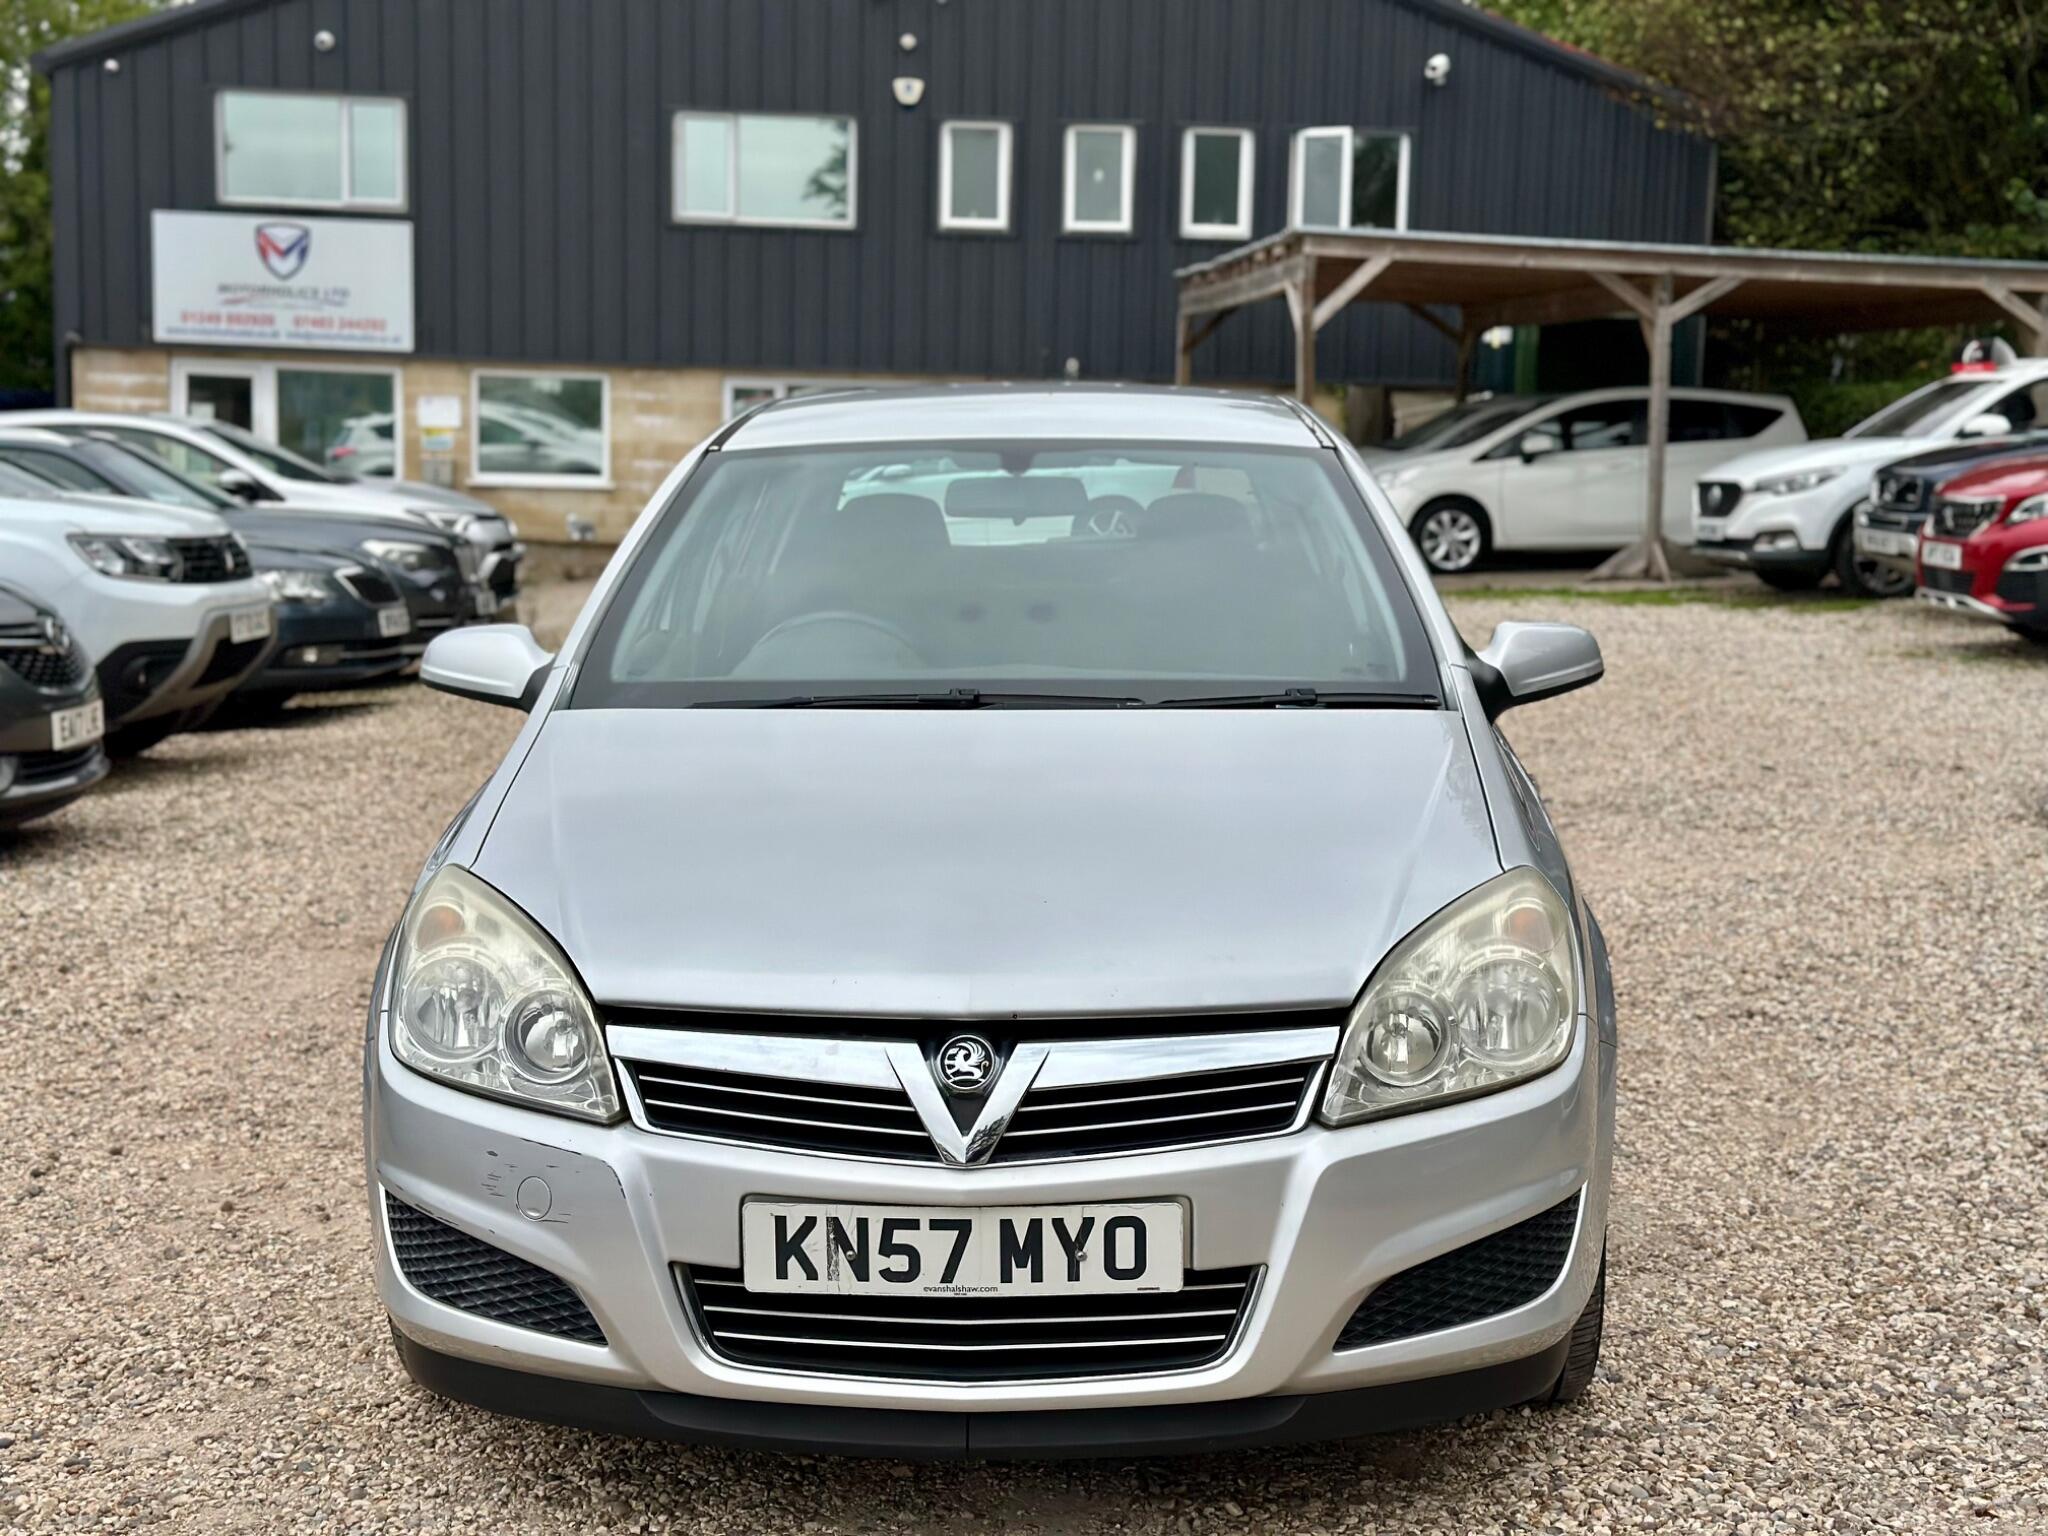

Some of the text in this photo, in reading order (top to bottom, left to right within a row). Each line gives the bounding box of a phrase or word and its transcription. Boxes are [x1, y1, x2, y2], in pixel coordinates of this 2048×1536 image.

[774, 1215, 1147, 1284] KN57 MYO
[923, 1284, 999, 1293] evanshalshaw.com
